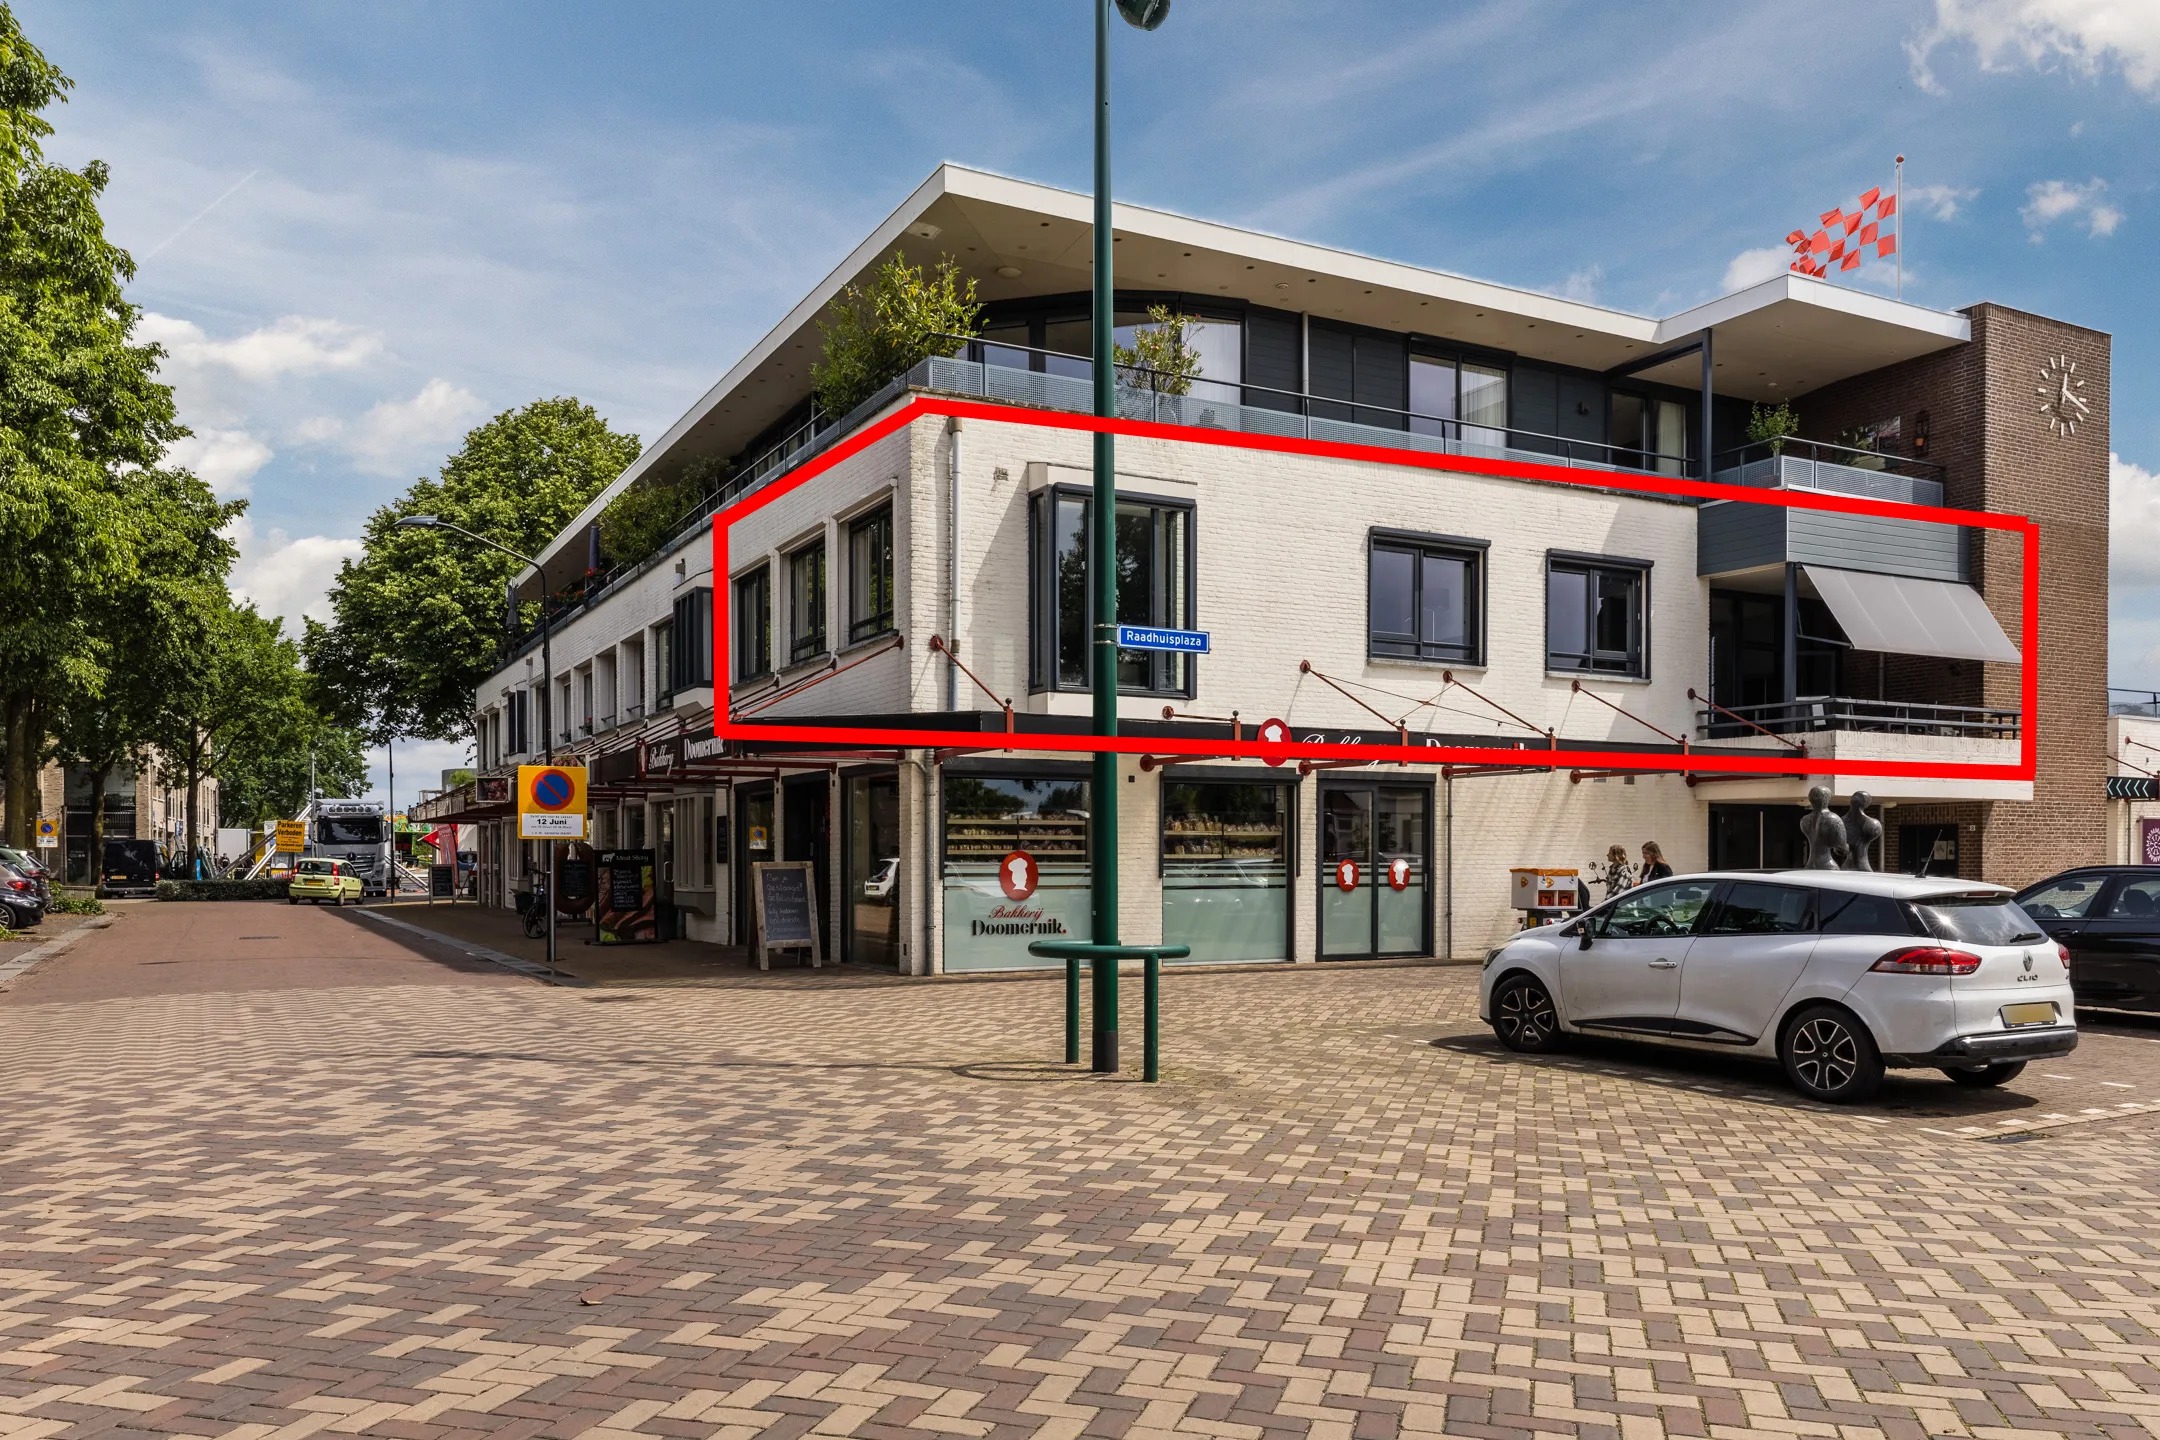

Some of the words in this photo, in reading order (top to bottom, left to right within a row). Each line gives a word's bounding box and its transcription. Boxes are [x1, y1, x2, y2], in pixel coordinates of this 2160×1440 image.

[1126, 630, 1202, 646] Raadhuisplaza
[277, 820, 302, 829] Parkeren
[632, 854, 649, 862] Story
[988, 904, 1044, 924] Bakkerij
[2017, 974, 2039, 982] CLIO
